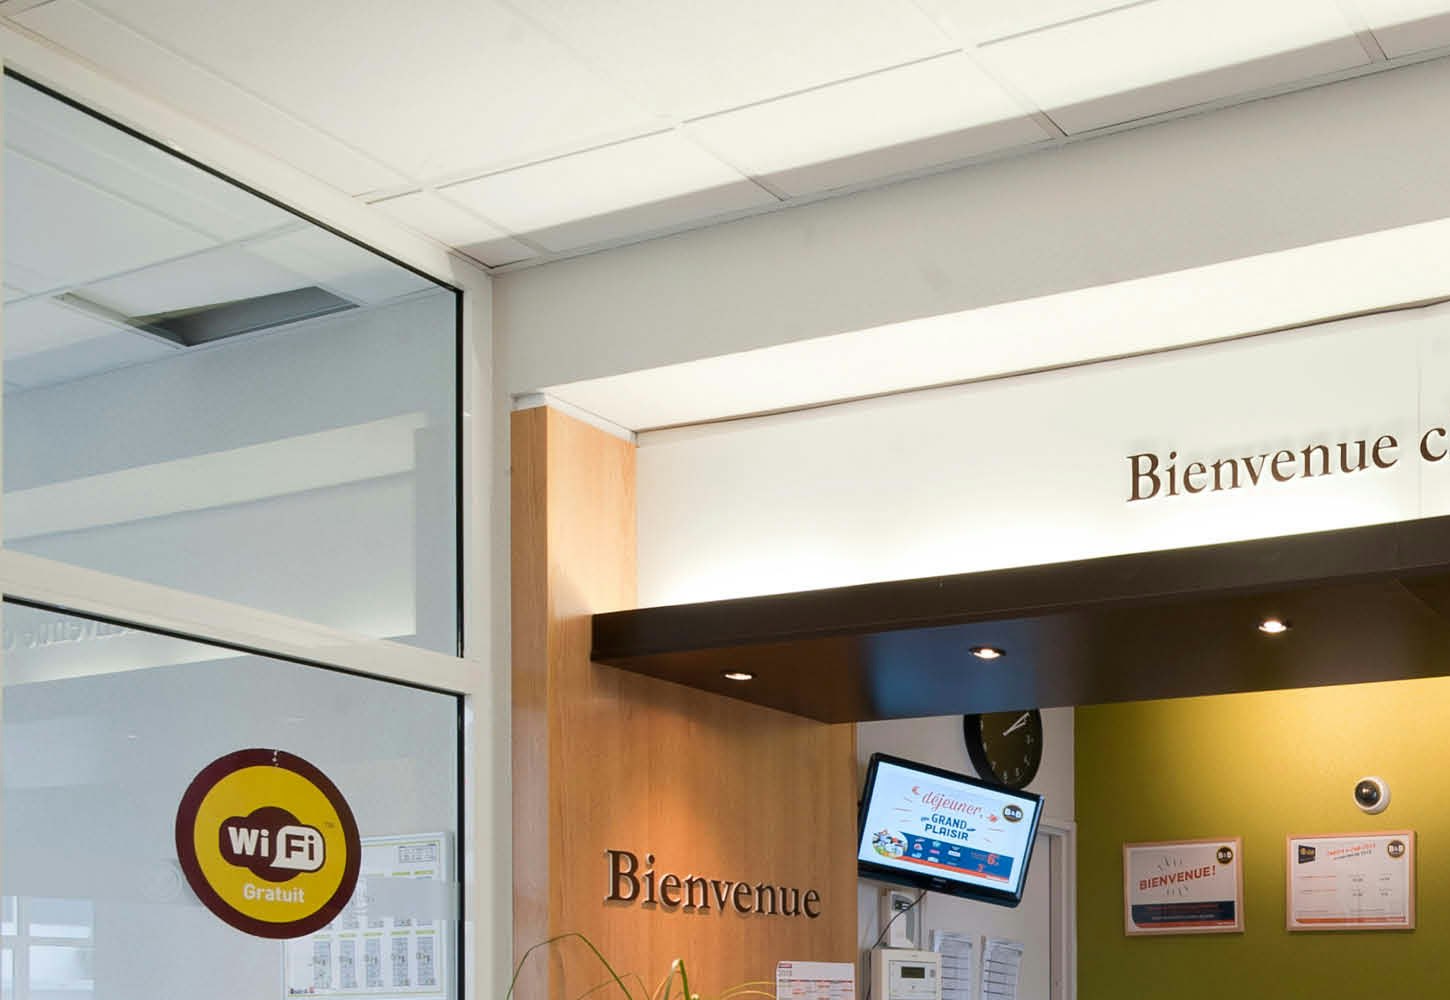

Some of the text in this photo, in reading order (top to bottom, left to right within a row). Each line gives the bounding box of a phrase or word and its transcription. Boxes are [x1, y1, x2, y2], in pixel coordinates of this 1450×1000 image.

[1126, 434, 1399, 502] Bienvenue
[925, 823, 969, 841] PLAISIR
[931, 813, 968, 830] GRAND
[242, 883, 305, 904] Gratuit
[604, 849, 821, 919] Bienvenue
